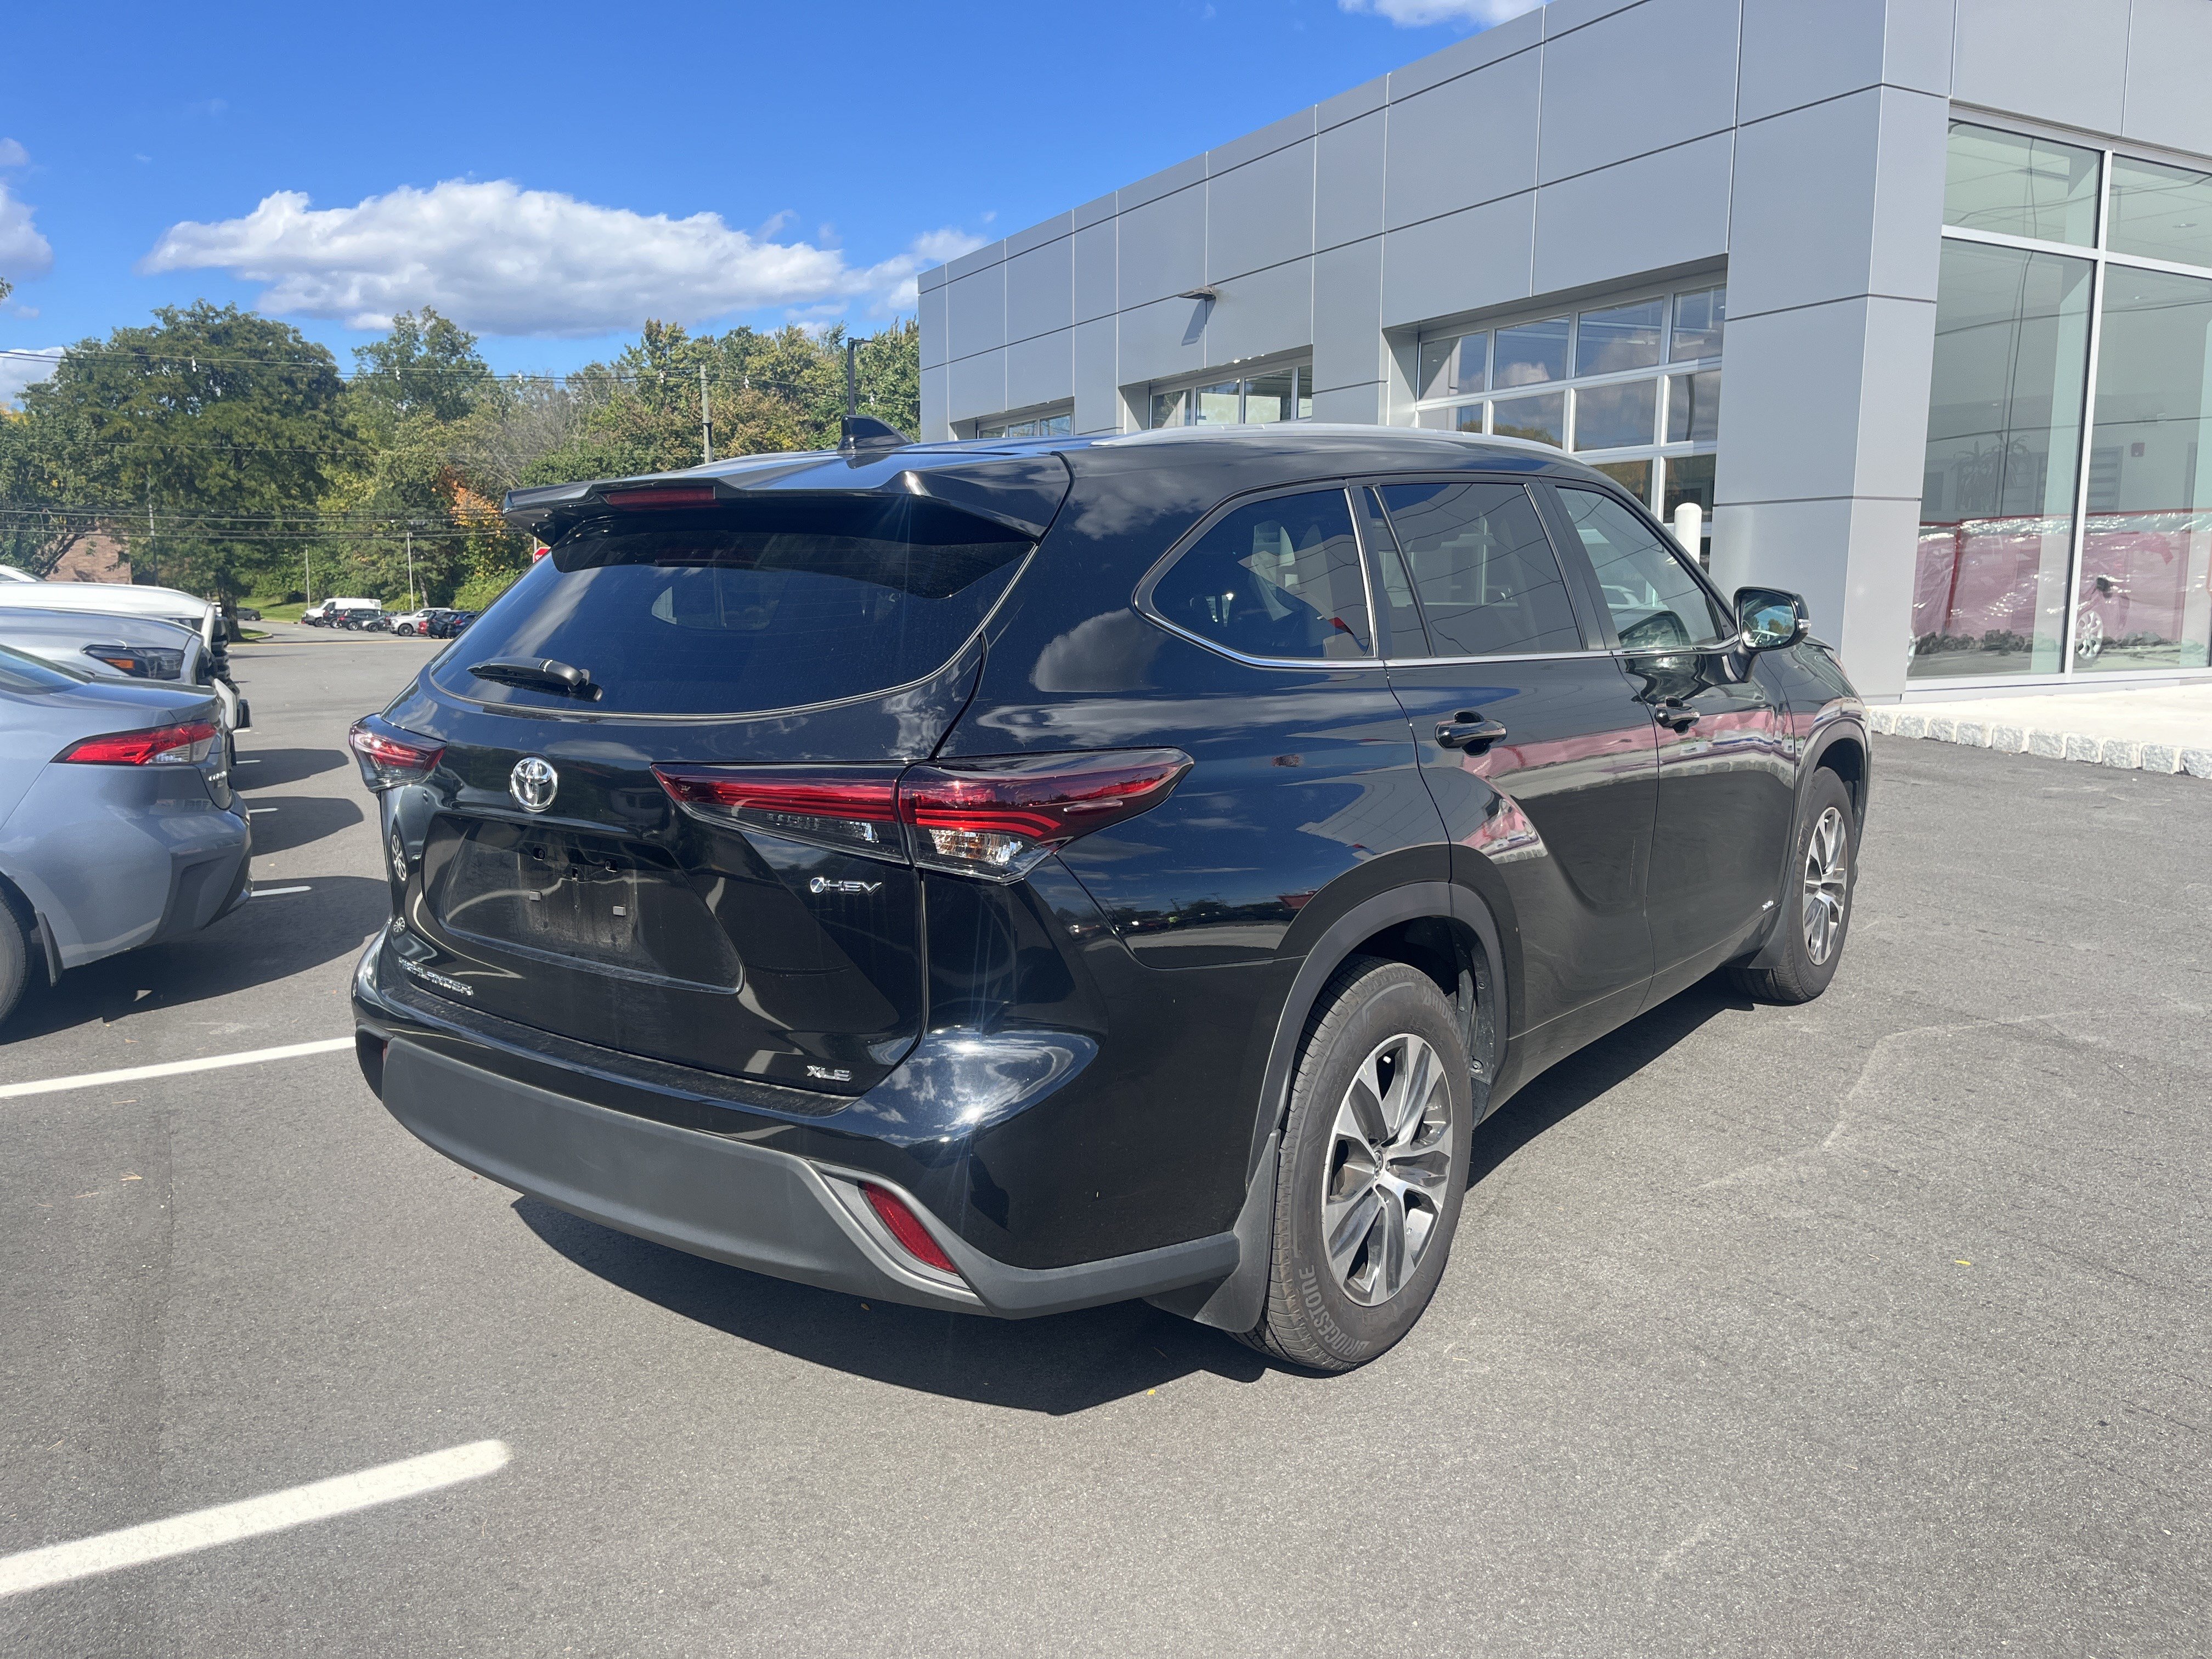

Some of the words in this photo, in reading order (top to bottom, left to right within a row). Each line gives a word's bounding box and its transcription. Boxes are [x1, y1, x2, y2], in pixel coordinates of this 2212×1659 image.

[826, 880, 882, 894] HEV
[806, 1065, 852, 1082] XLE
[1298, 1264, 1370, 1359] BRIDGESTONE
